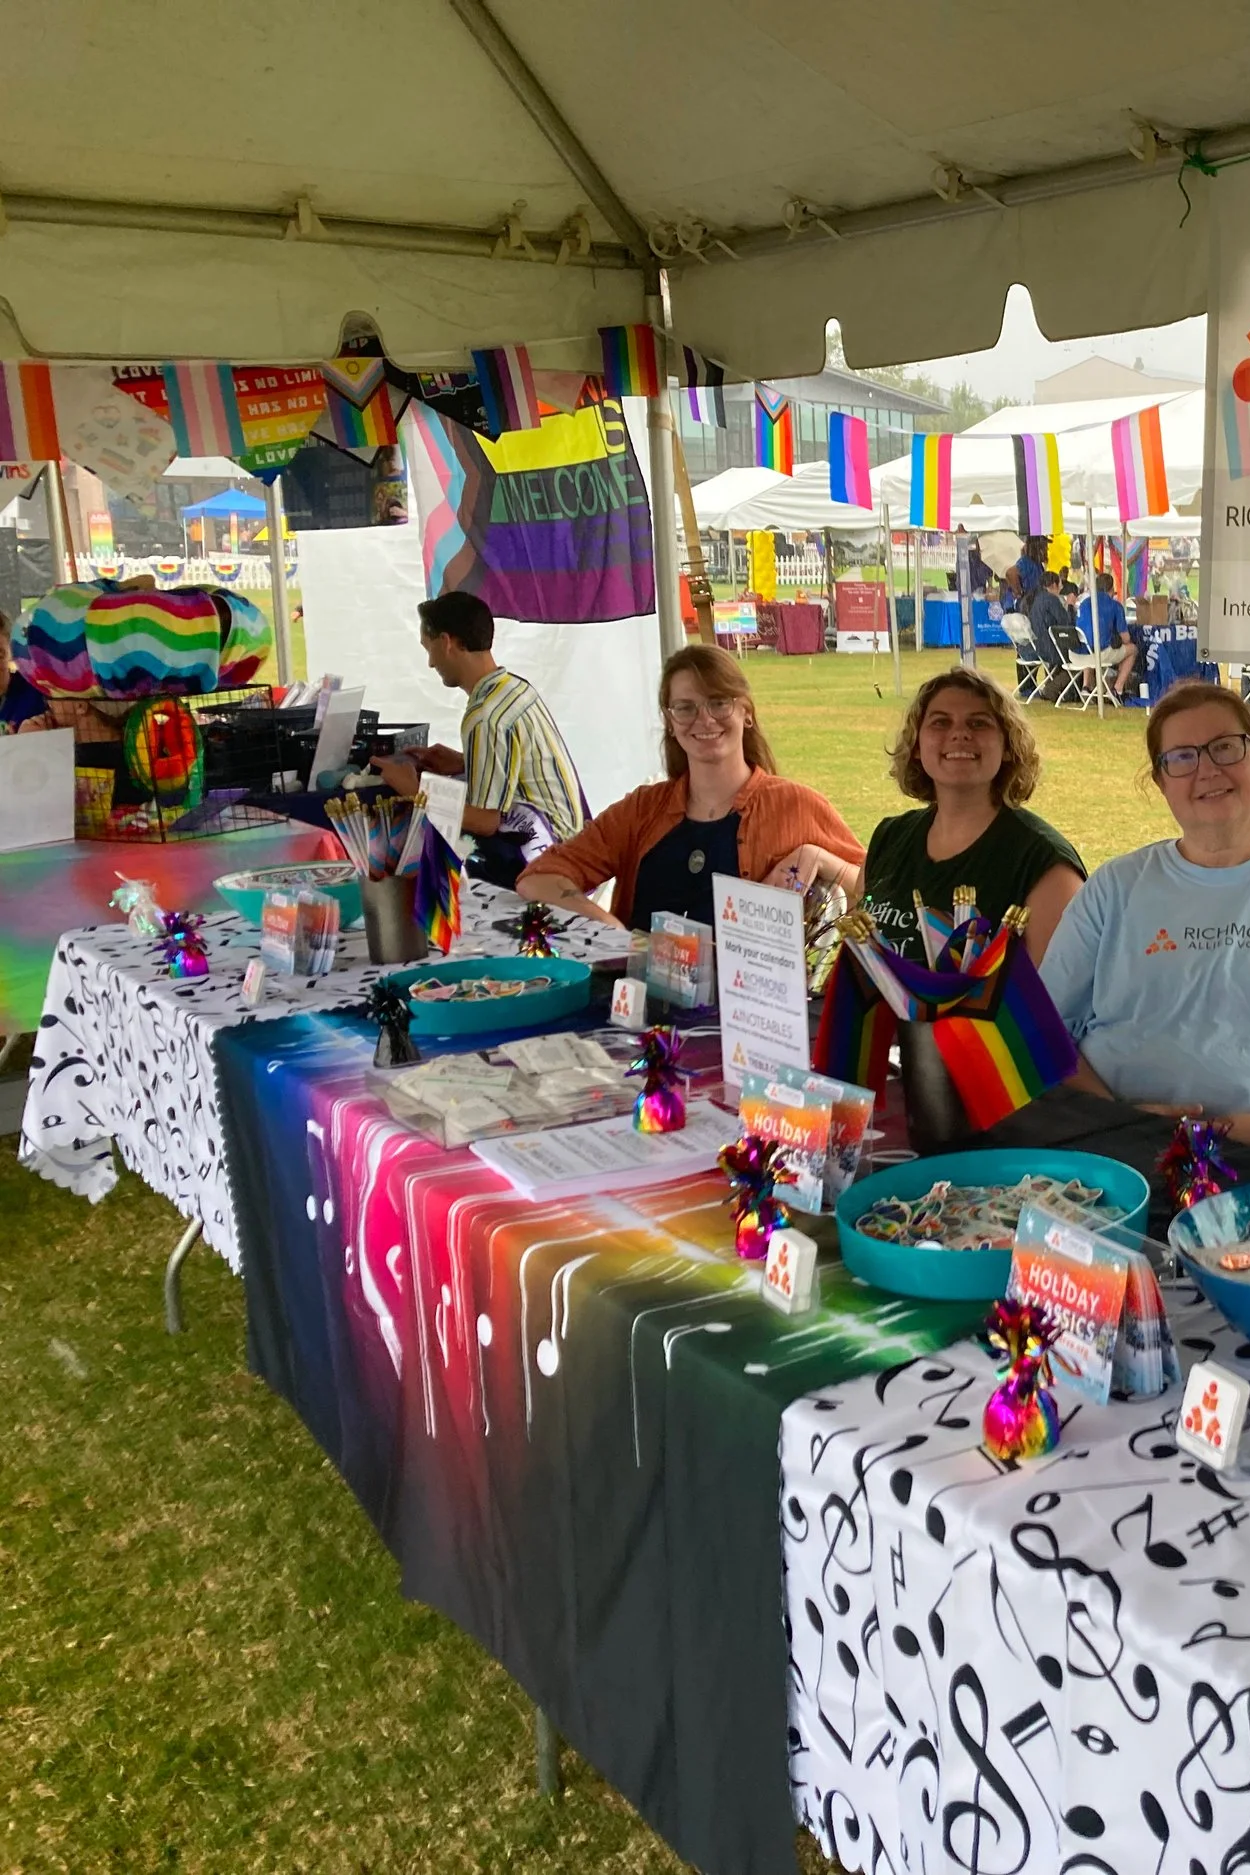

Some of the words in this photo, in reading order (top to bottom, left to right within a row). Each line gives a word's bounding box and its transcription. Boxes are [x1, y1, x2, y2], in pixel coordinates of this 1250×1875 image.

[254, 376, 278, 389] NO
[248, 401, 281, 416] HAS
[287, 396, 308, 409] NO
[499, 453, 645, 522] WELCOME
[1176, 624, 1198, 640] Ba
[738, 898, 794, 926] RICHMOND
[1188, 938, 1234, 951] ALLIED
[753, 1112, 812, 1147] HOLIDAY
[1029, 1263, 1100, 1314] HOLIDAY
